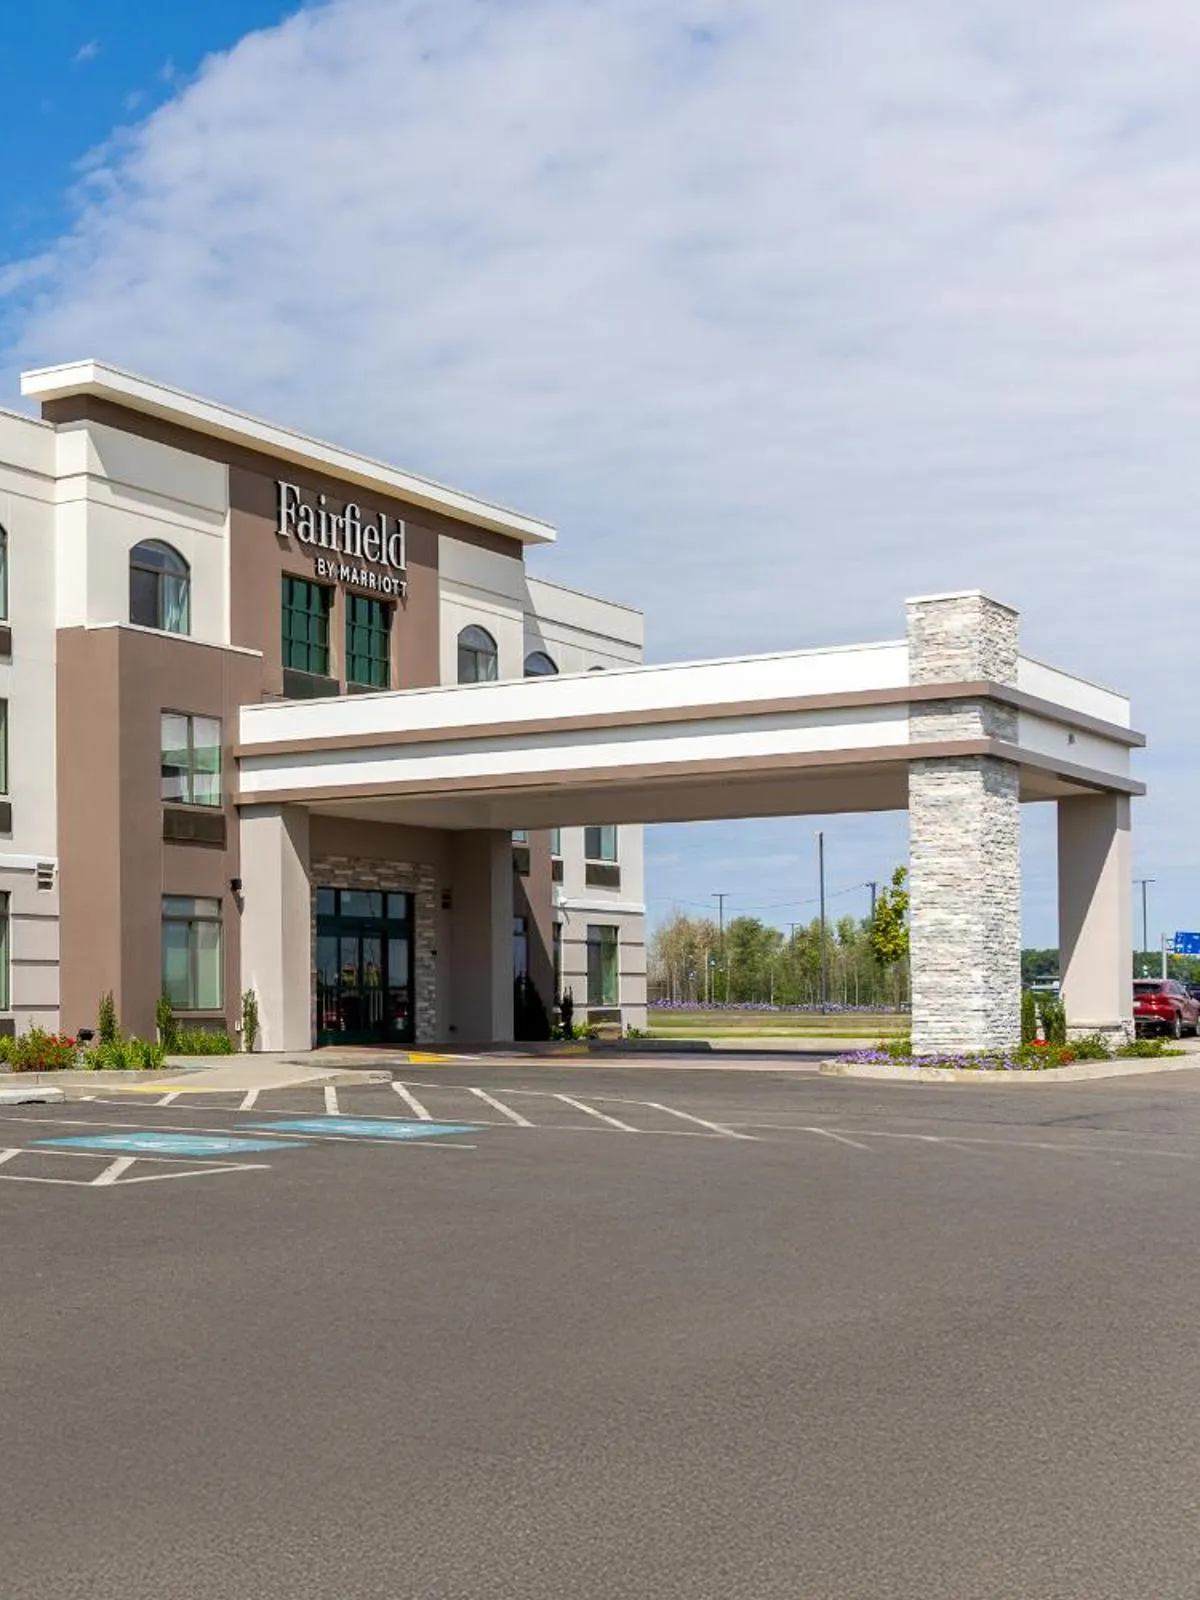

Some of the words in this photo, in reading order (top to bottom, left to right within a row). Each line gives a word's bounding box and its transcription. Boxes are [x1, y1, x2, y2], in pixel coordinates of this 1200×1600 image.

[277, 481, 407, 570] Fairfield
[317, 558, 334, 577] BY
[340, 565, 407, 596] MARRIOTT
